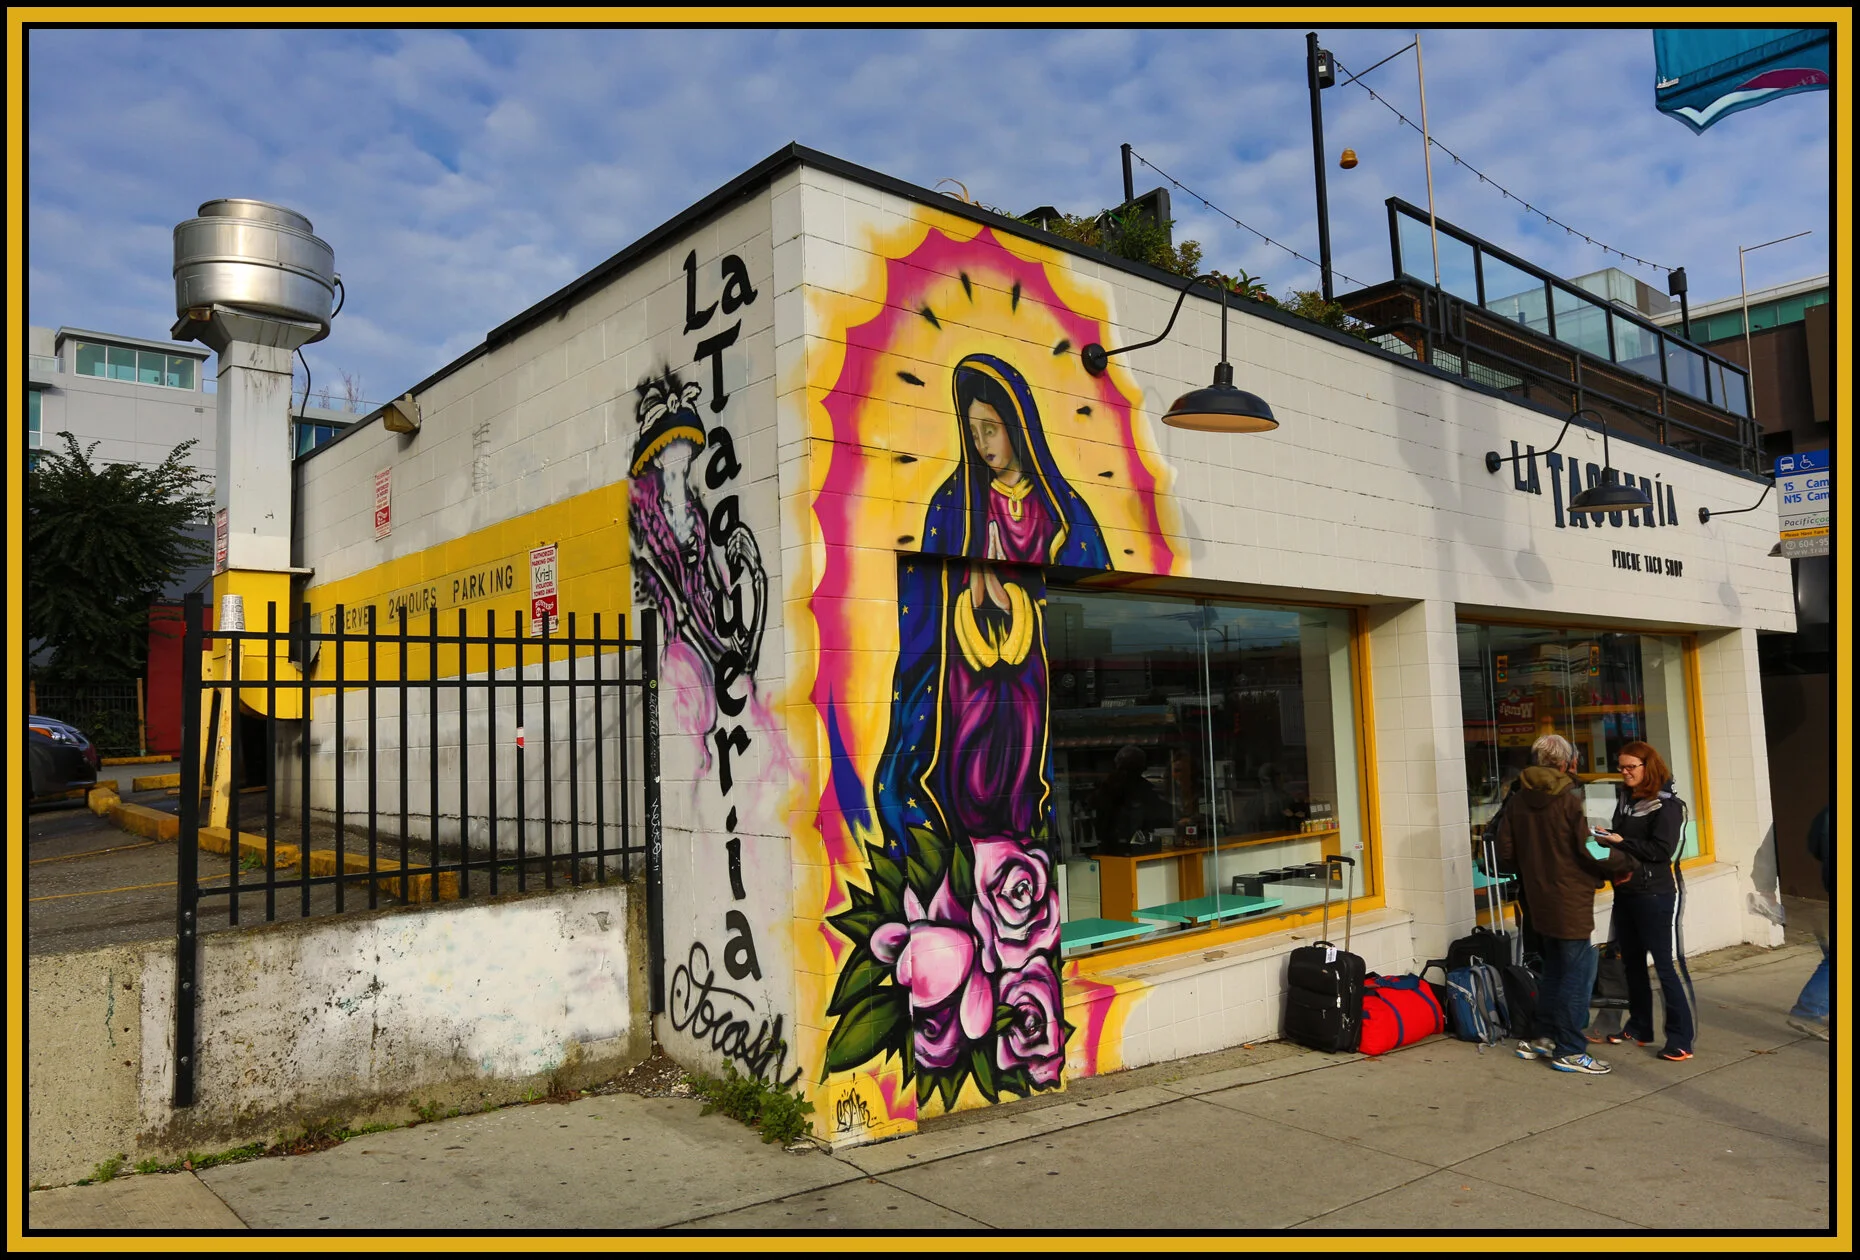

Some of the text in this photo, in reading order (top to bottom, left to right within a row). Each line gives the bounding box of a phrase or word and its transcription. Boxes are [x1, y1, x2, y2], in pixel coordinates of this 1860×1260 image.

[683, 249, 758, 335] La
[1510, 440, 1542, 495] LA
[1784, 479, 1829, 491] 15 Cam
[1784, 491, 1829, 504] N15 Cam
[1612, 550, 1683, 577] PINCHE TACO SHOP
[453, 565, 513, 602] PARKING
